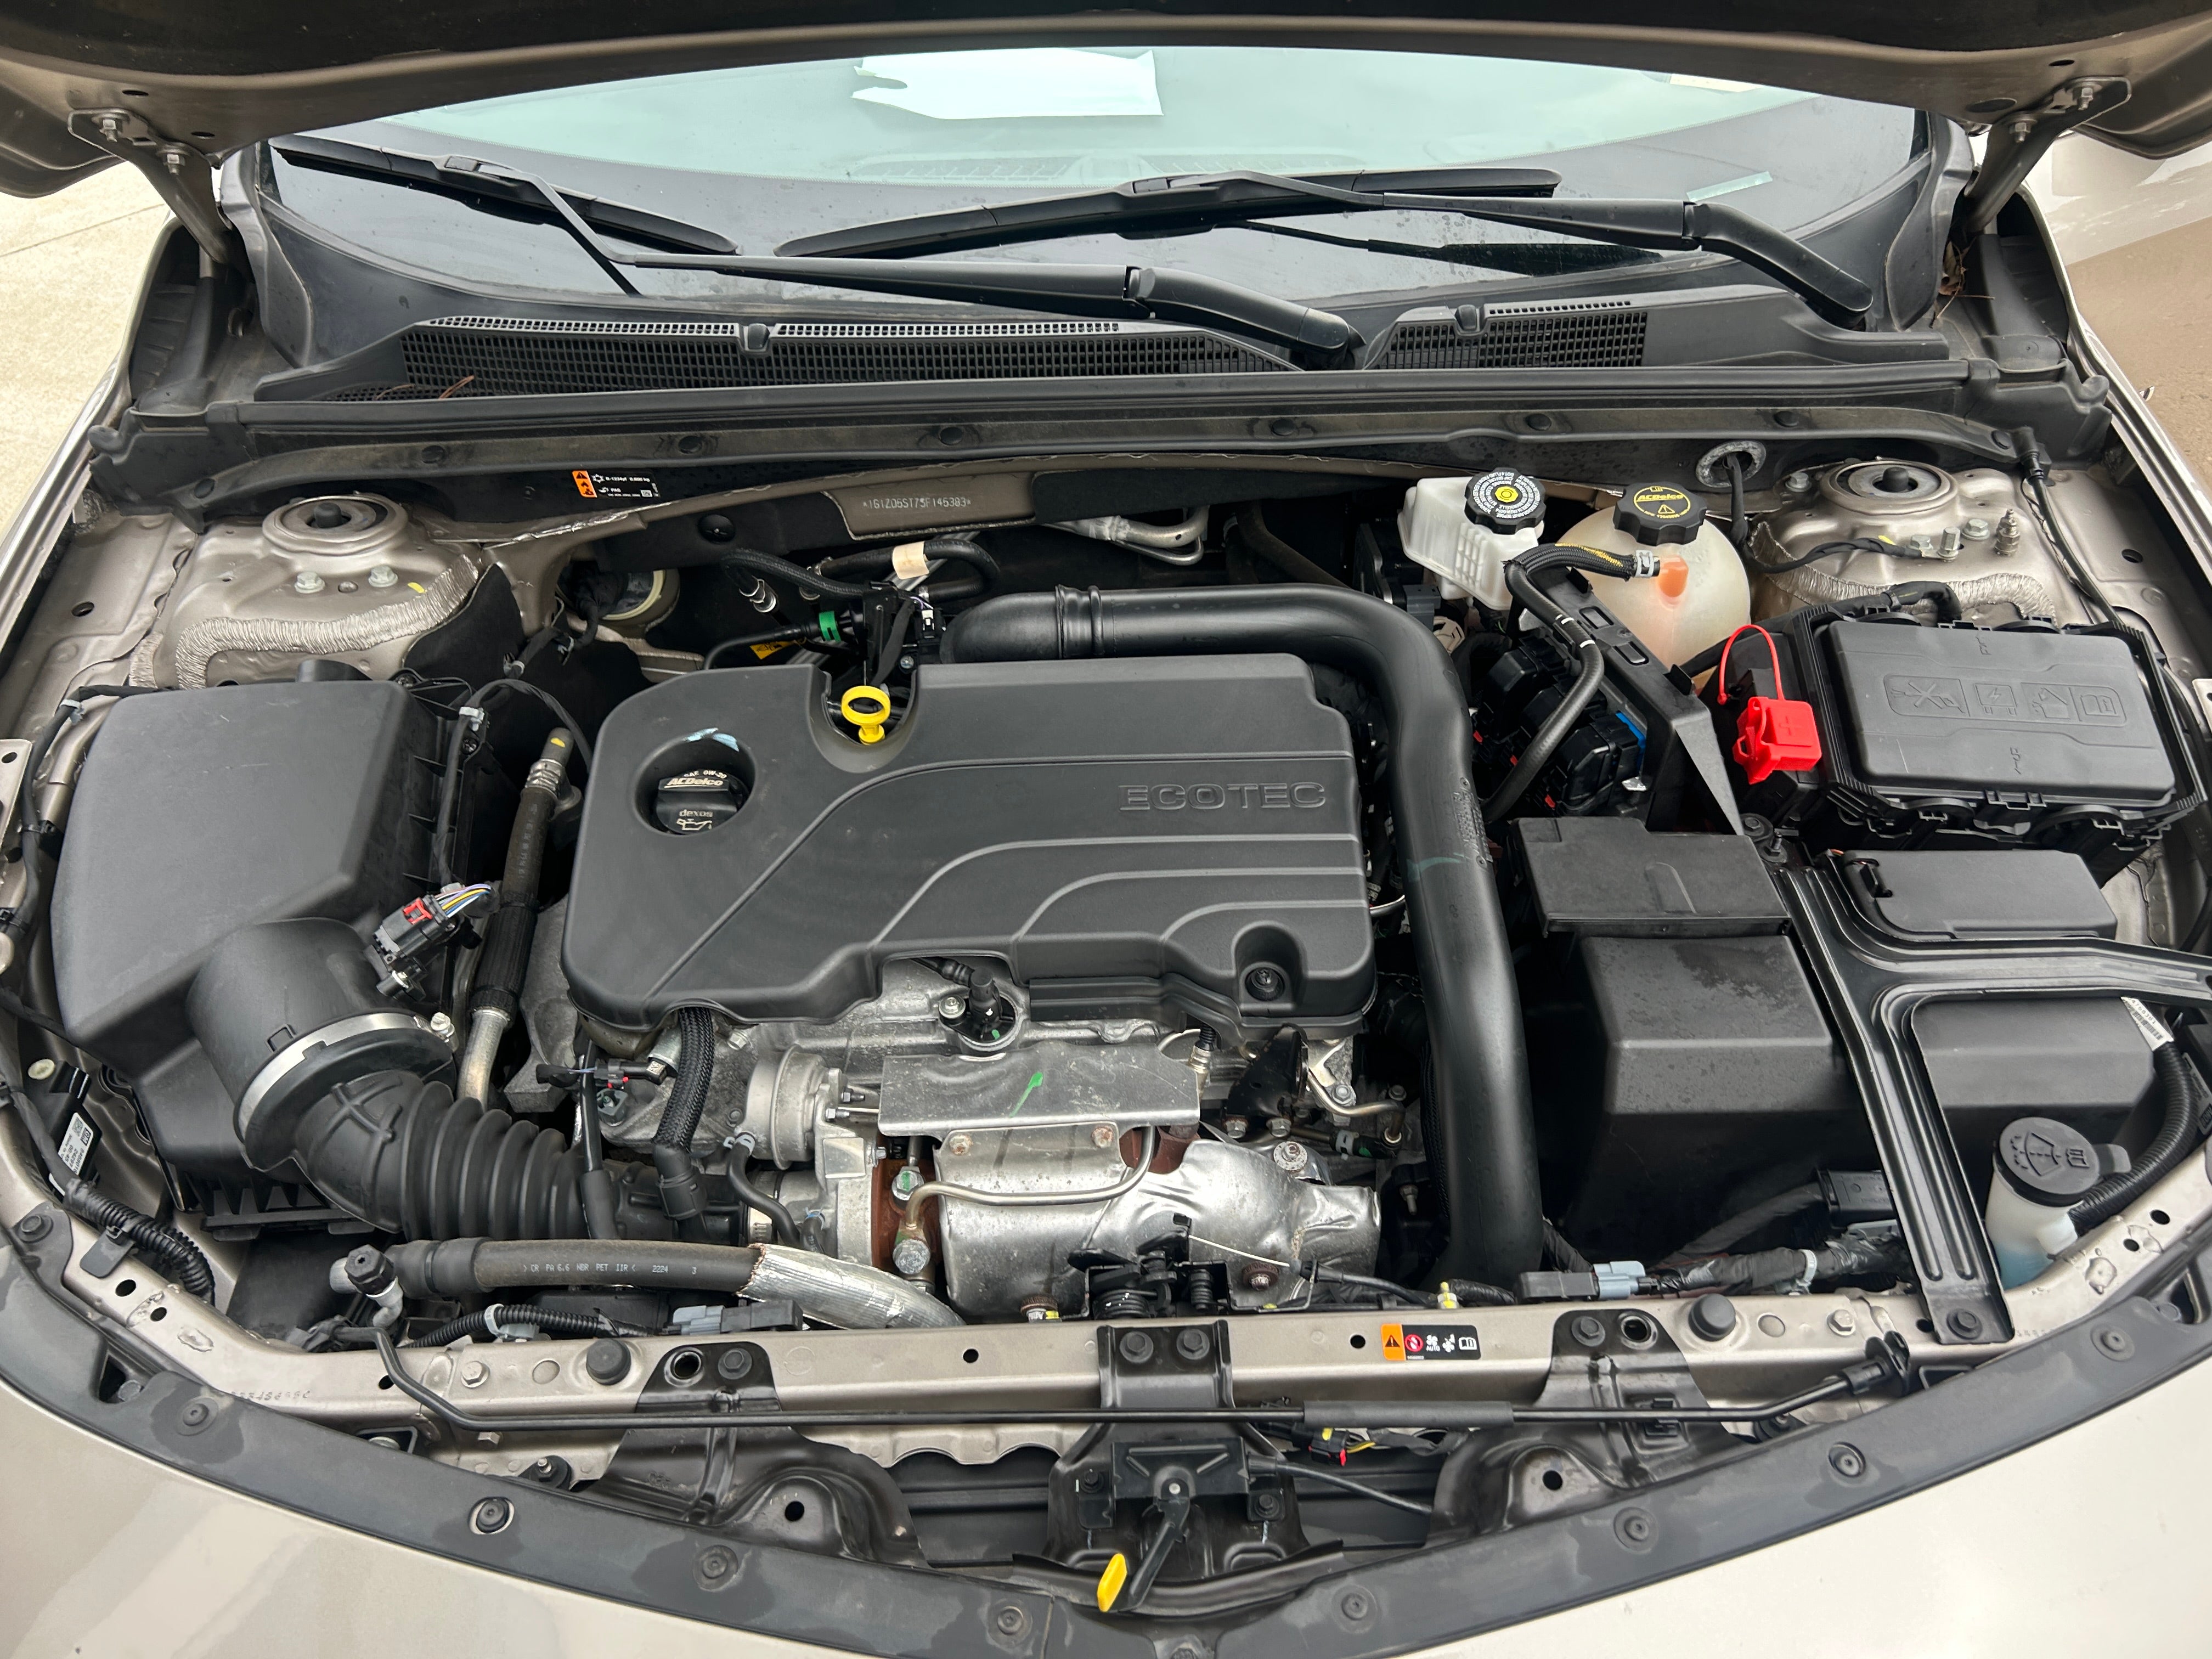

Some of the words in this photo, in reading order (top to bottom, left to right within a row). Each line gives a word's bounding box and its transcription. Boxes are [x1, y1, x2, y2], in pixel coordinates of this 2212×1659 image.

[667, 777, 724, 786] ACDelco
[1118, 781, 1326, 811] ECOTEC
[679, 809, 713, 817] dexos
